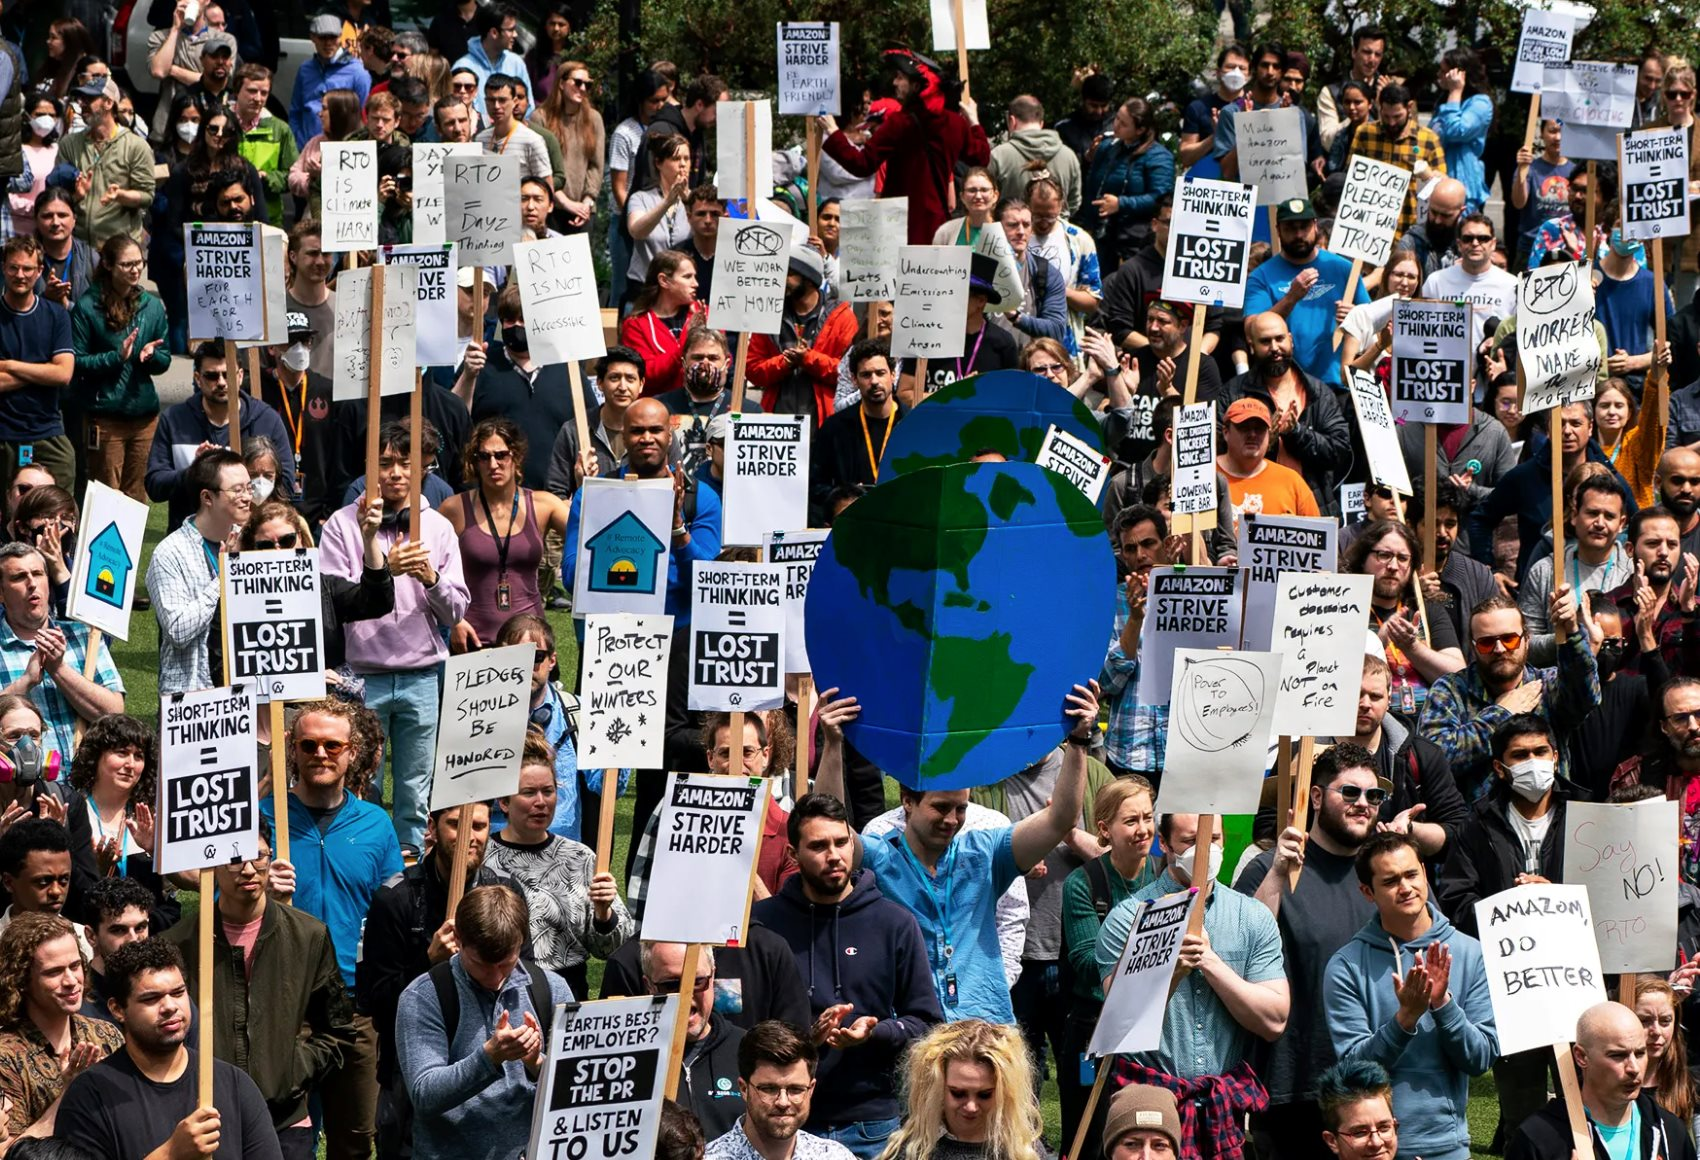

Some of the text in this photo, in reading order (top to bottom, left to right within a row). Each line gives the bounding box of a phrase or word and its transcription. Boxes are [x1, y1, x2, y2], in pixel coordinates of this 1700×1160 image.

[785, 43, 829, 55] STRIVE
[785, 55, 829, 66] HARDER
[792, 78, 828, 89] EARTH
[784, 90, 834, 102] FRIENDLY
[1625, 135, 1684, 150] SHORT-TERM
[340, 150, 370, 171] RTO
[1625, 146, 1684, 164] THINKING
[454, 163, 502, 185] RTO
[1182, 186, 1251, 204] SHORT-TERM
[1344, 182, 1402, 211] PLEDGES
[1632, 180, 1678, 203] LOST
[1181, 199, 1249, 219] THINKING
[1629, 198, 1683, 221] TRUST
[336, 221, 373, 240] HARM
[1182, 236, 1238, 260] LOST
[1339, 224, 1390, 262] TRUST
[195, 250, 251, 265] STRIVE
[528, 248, 571, 274] RTO
[724, 259, 784, 273] WE WORK
[196, 265, 252, 279] HARDER
[846, 269, 880, 283] Lets
[901, 257, 967, 280] Undercounting
[1176, 256, 1241, 282] TRUST
[204, 281, 230, 294] FOR
[419, 271, 446, 287] IVE
[555, 277, 583, 290] NOT
[737, 275, 782, 288] BETTER
[198, 292, 253, 308] EARTH
[417, 287, 446, 301] DER
[900, 283, 954, 297] Emissions
[212, 307, 237, 317] FOR
[717, 295, 783, 313] AT HOME
[900, 316, 944, 329] Climate
[1397, 309, 1466, 323] SHORT-TERM
[1397, 321, 1465, 339] THINKING
[1402, 360, 1457, 381] LOST
[1536, 347, 1582, 378] MAKE
[1399, 379, 1462, 401] TRUST
[736, 444, 798, 461] STRIVE
[1053, 440, 1099, 476] AMAZON:
[736, 461, 797, 476] HARDER
[1045, 456, 1092, 494] STRIVE
[1176, 482, 1213, 499] LOWERING
[1180, 496, 1212, 512] THE BAR
[614, 533, 646, 543] Remote
[1254, 527, 1323, 547] AMAZON:
[606, 545, 646, 555] Advocacy
[1251, 547, 1323, 570] STRIVE
[229, 558, 314, 577] SHORT-TERM
[229, 575, 315, 595] THINKING
[697, 571, 780, 587] SHORT-TERM
[697, 586, 780, 607] THINKING
[1156, 598, 1229, 617] STRIVE
[1155, 616, 1229, 633] HARDER
[241, 621, 307, 649] LOST
[597, 626, 669, 656] PROTECT
[704, 633, 769, 659] LOST
[237, 647, 315, 675] TRUST
[608, 659, 652, 679] OUR
[1305, 660, 1340, 675] Planet
[455, 667, 525, 692] PLEDGES
[697, 658, 775, 685] TRUST
[1280, 675, 1338, 692] NOT on
[591, 690, 657, 709] WINTERS
[1210, 690, 1228, 699] TO
[167, 695, 251, 723] SHORT-TERM
[456, 693, 520, 722] SHOULD
[167, 714, 251, 746] THINKING
[470, 719, 498, 739] BE
[445, 748, 516, 772] HONORED
[176, 771, 242, 809] LOST
[677, 788, 752, 808] AMAZON:
[170, 801, 249, 839] TRUST
[671, 811, 747, 835] STRIVE
[668, 833, 743, 855] HARDER
[1574, 821, 1637, 874] Say
[1622, 857, 1665, 900] NO!
[1597, 915, 1647, 946] RTO
[1132, 926, 1181, 957] STRIVE
[1499, 936, 1537, 958] DO
[1124, 947, 1174, 976] HARDER
[1503, 966, 1598, 996] BETTER
[565, 1010, 663, 1034] EARTH'S BEST
[562, 1026, 660, 1052] EMPLOYER?
[573, 1056, 638, 1084] STOP
[570, 1080, 636, 1104] THE PR
[572, 1108, 643, 1134] LISTEN
[547, 1129, 642, 1160] TO US
